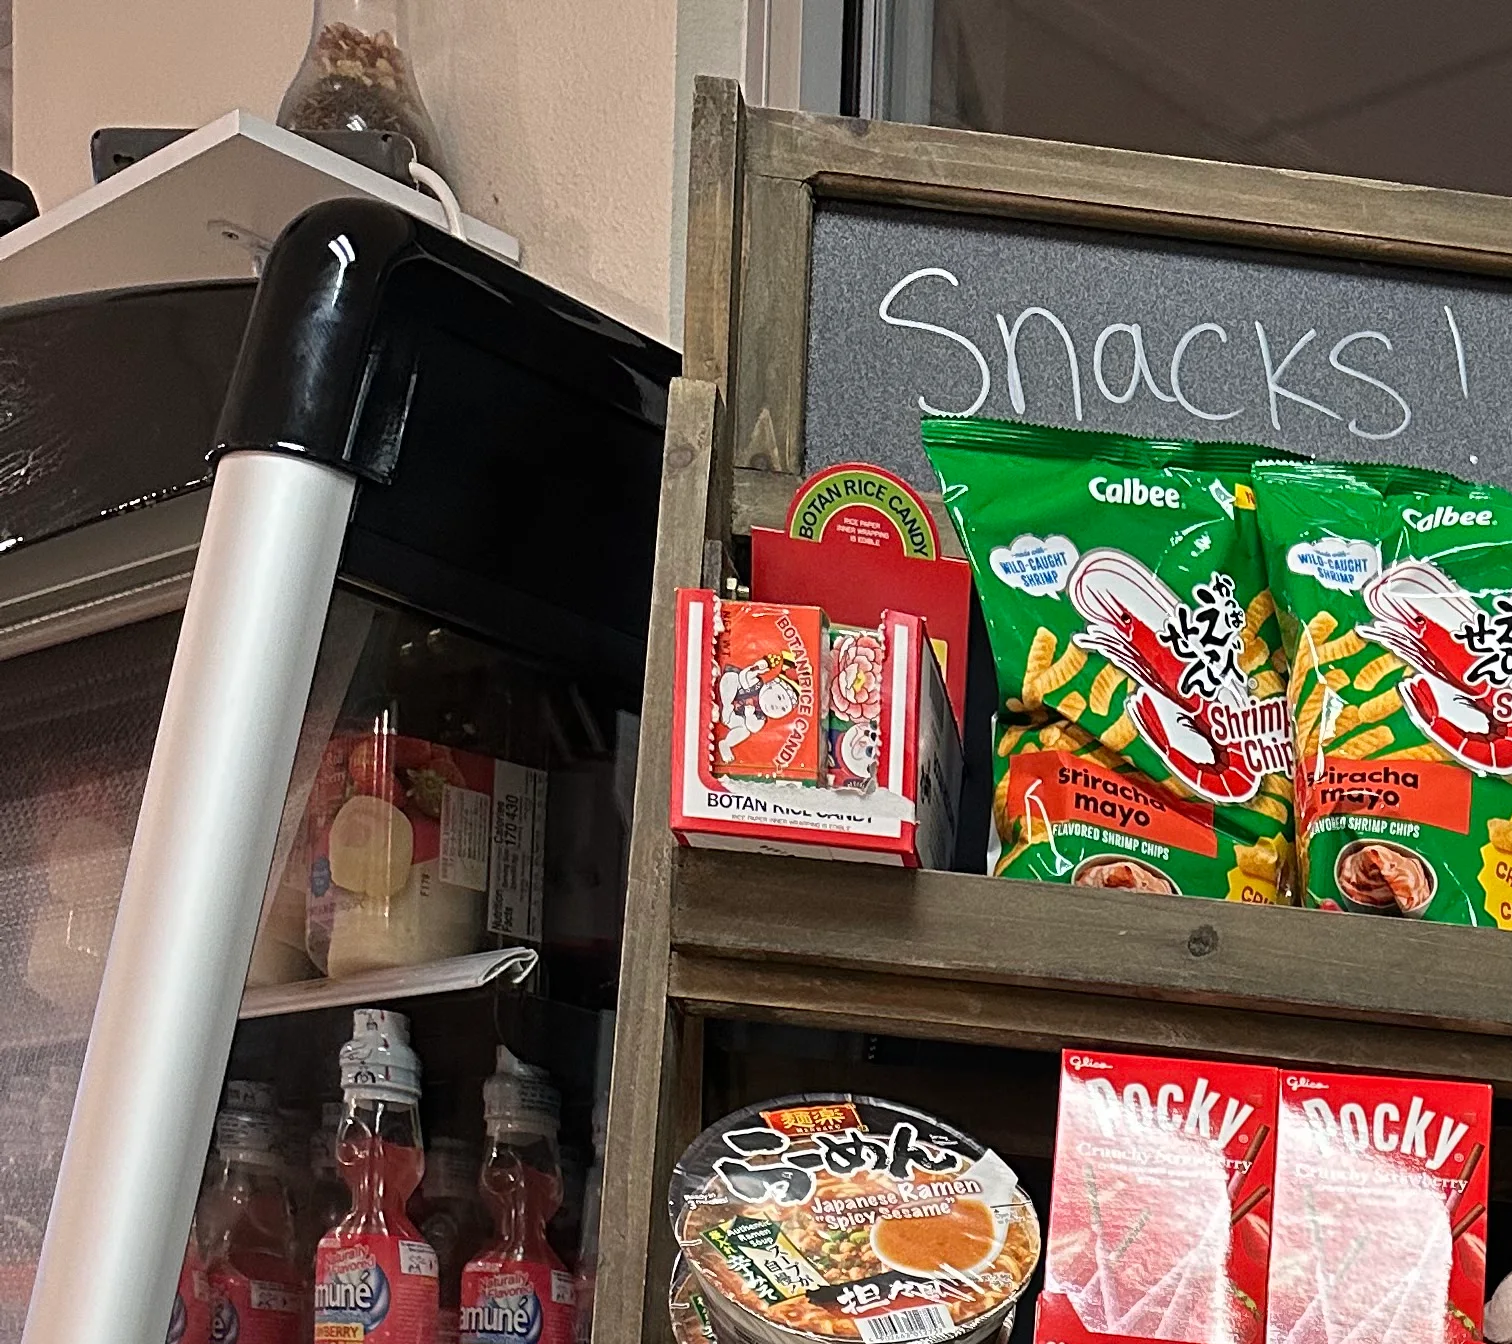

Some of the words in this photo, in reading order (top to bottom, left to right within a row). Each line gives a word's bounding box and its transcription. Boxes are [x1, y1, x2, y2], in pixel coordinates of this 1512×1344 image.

[1089, 477, 1181, 510] Calbee
[799, 484, 842, 539] BOTAN
[844, 480, 888, 502] RICE
[889, 495, 929, 557] CANDY
[1402, 506, 1496, 531] Calbee
[999, 552, 1067, 575] WILD-CAUGHT
[1298, 553, 1368, 573] WILD-CAUGHT
[1317, 566, 1354, 585] SHRIMP
[1020, 570, 1058, 587] SHRIMP
[777, 617, 811, 672] BOTAN
[800, 672, 813, 715] RICE
[773, 719, 809, 773] CANDY
[707, 791, 767, 814] BOTAN
[1058, 765, 1167, 813] sriracha
[1321, 787, 1400, 811] mayo
[493, 800, 505, 844] Calories
[505, 794, 519, 823] 430
[1074, 789, 1150, 829] mayo
[504, 823, 517, 847] 170
[1053, 821, 1101, 843] FLAVORED
[1102, 826, 1139, 853] SHRIMP
[1141, 839, 1170, 861] CHIPS
[1348, 817, 1388, 835] SHRIMP
[1389, 821, 1420, 839] CHIPS
[492, 889, 504, 930] Nutrition
[502, 906, 513, 932] Facts
[712, 1123, 972, 1205] らーめん
[811, 1192, 898, 1214] Japanese
[897, 1179, 981, 1203] Ramen
[726, 1218, 772, 1238] Authentic
[737, 1229, 771, 1243] Ramen
[749, 1237, 774, 1248] Soup
[315, 1270, 373, 1311] muné
[481, 1270, 530, 1288] Naturally
[459, 1297, 529, 1334] amuné
